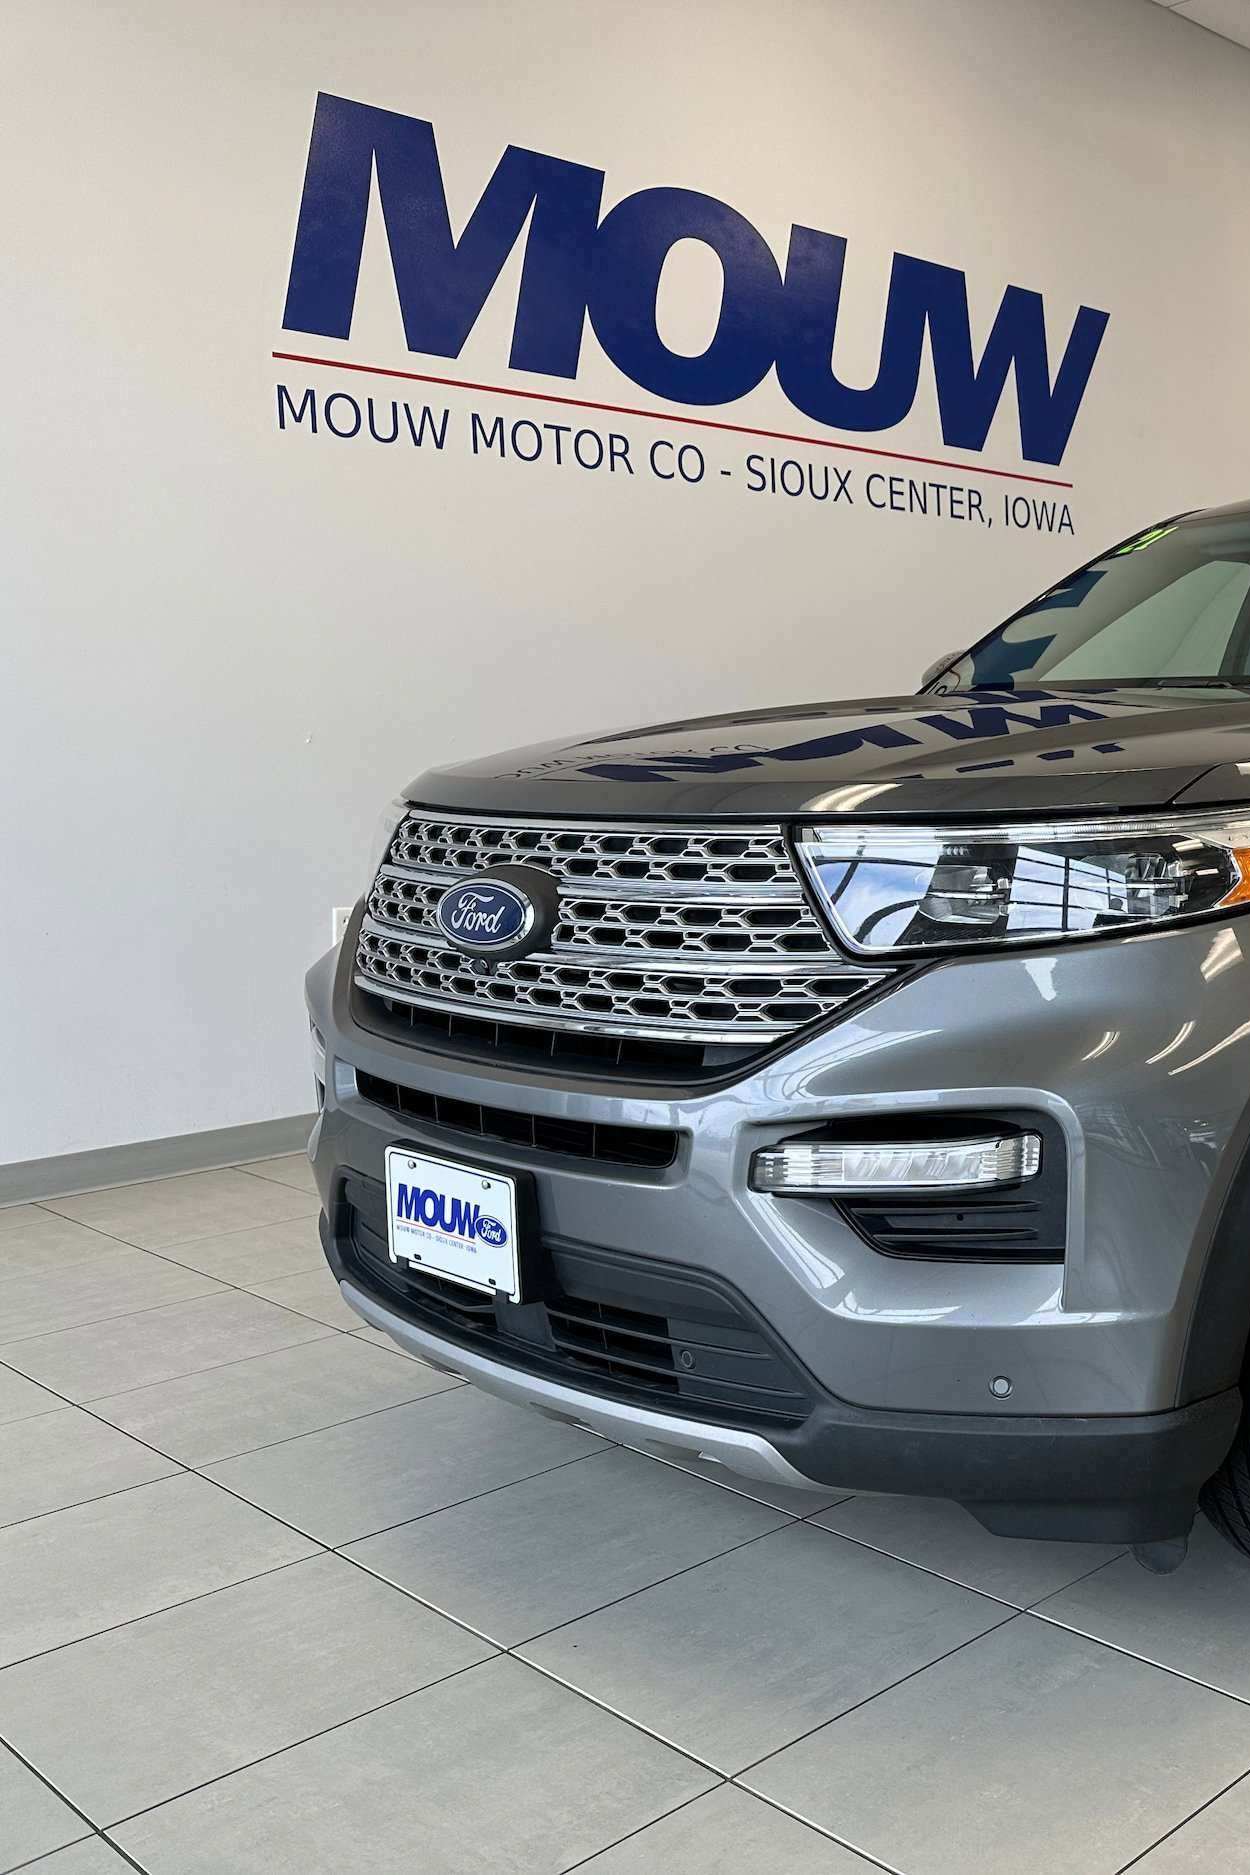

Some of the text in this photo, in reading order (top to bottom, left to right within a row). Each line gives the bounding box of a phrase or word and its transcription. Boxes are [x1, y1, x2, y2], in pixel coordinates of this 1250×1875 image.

[282, 91, 1110, 466] MOUW
[277, 384, 450, 449] MOUW
[471, 412, 634, 475] MOTOR
[649, 440, 705, 483] CO
[746, 454, 853, 504] SIOUX
[865, 473, 993, 529] CENTER,
[1004, 494, 1075, 535] IOWA
[451, 892, 506, 934] Ford
[397, 1183, 502, 1242] MOUW Ford
